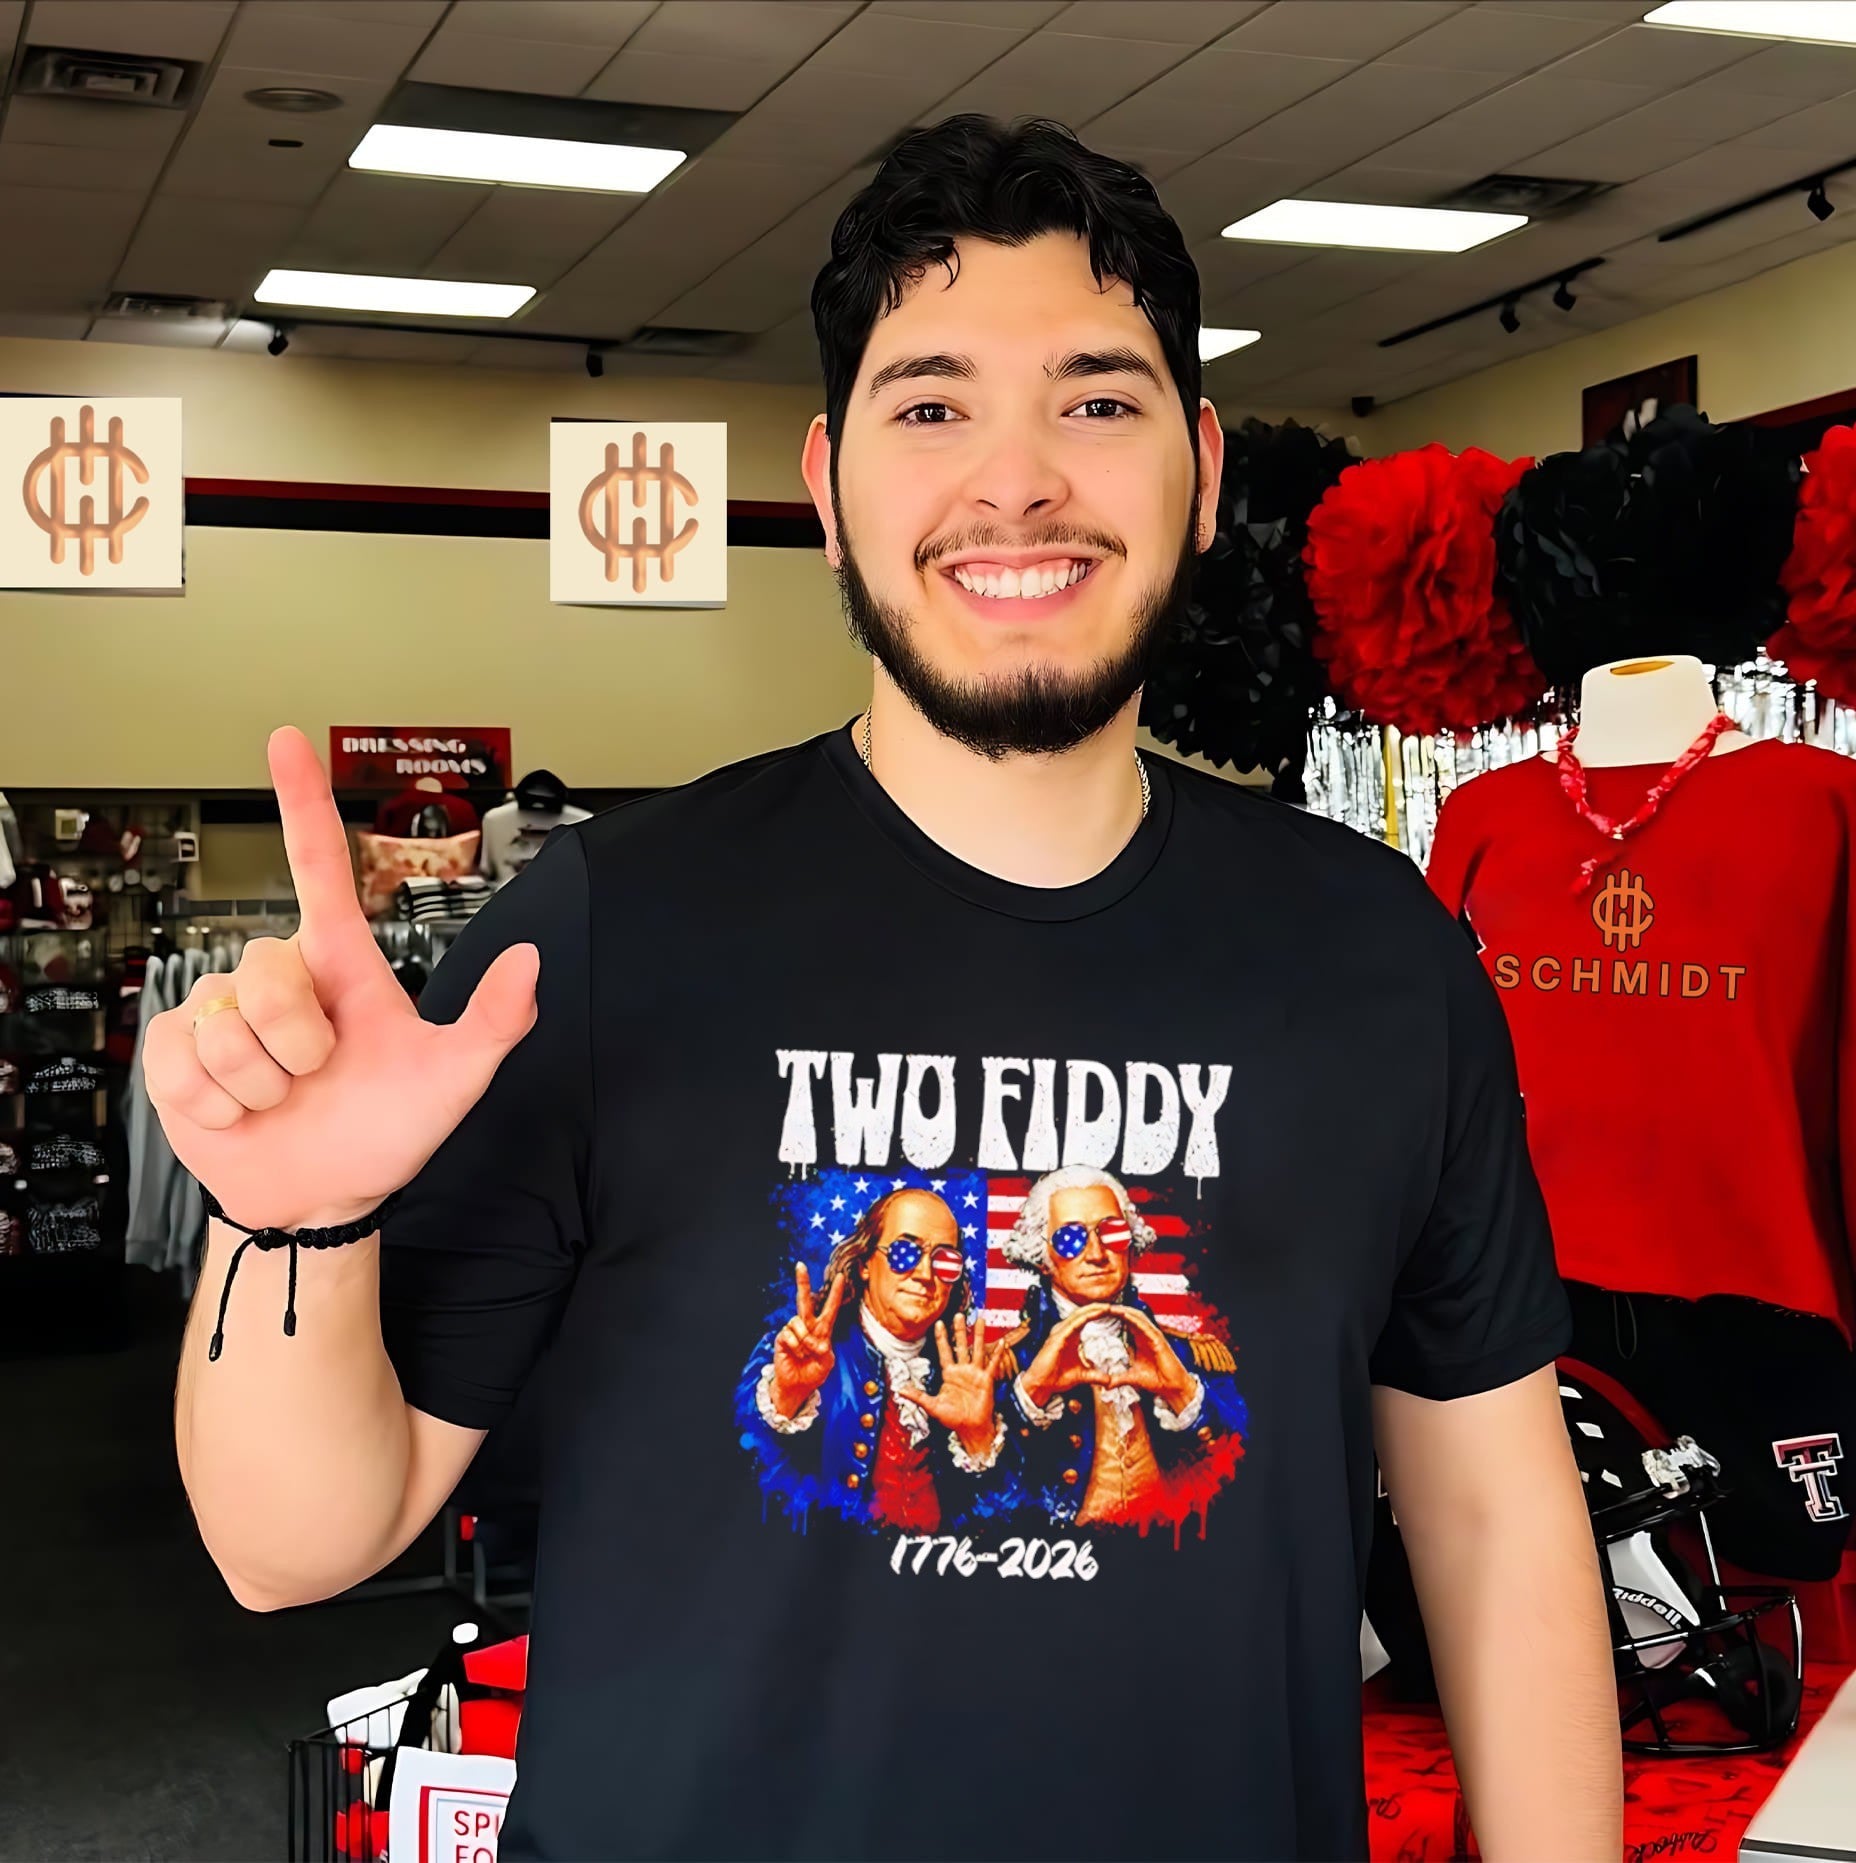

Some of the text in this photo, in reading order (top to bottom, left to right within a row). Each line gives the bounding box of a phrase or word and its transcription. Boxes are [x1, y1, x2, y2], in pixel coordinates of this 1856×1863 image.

[342, 737, 466, 754] DRESSING
[396, 758, 487, 775] ROOMS
[1494, 953, 1747, 1000] SCHMIDT
[775, 1049, 1233, 1178] TWO FIDDY
[889, 1533, 1099, 1581] 1776-2026
